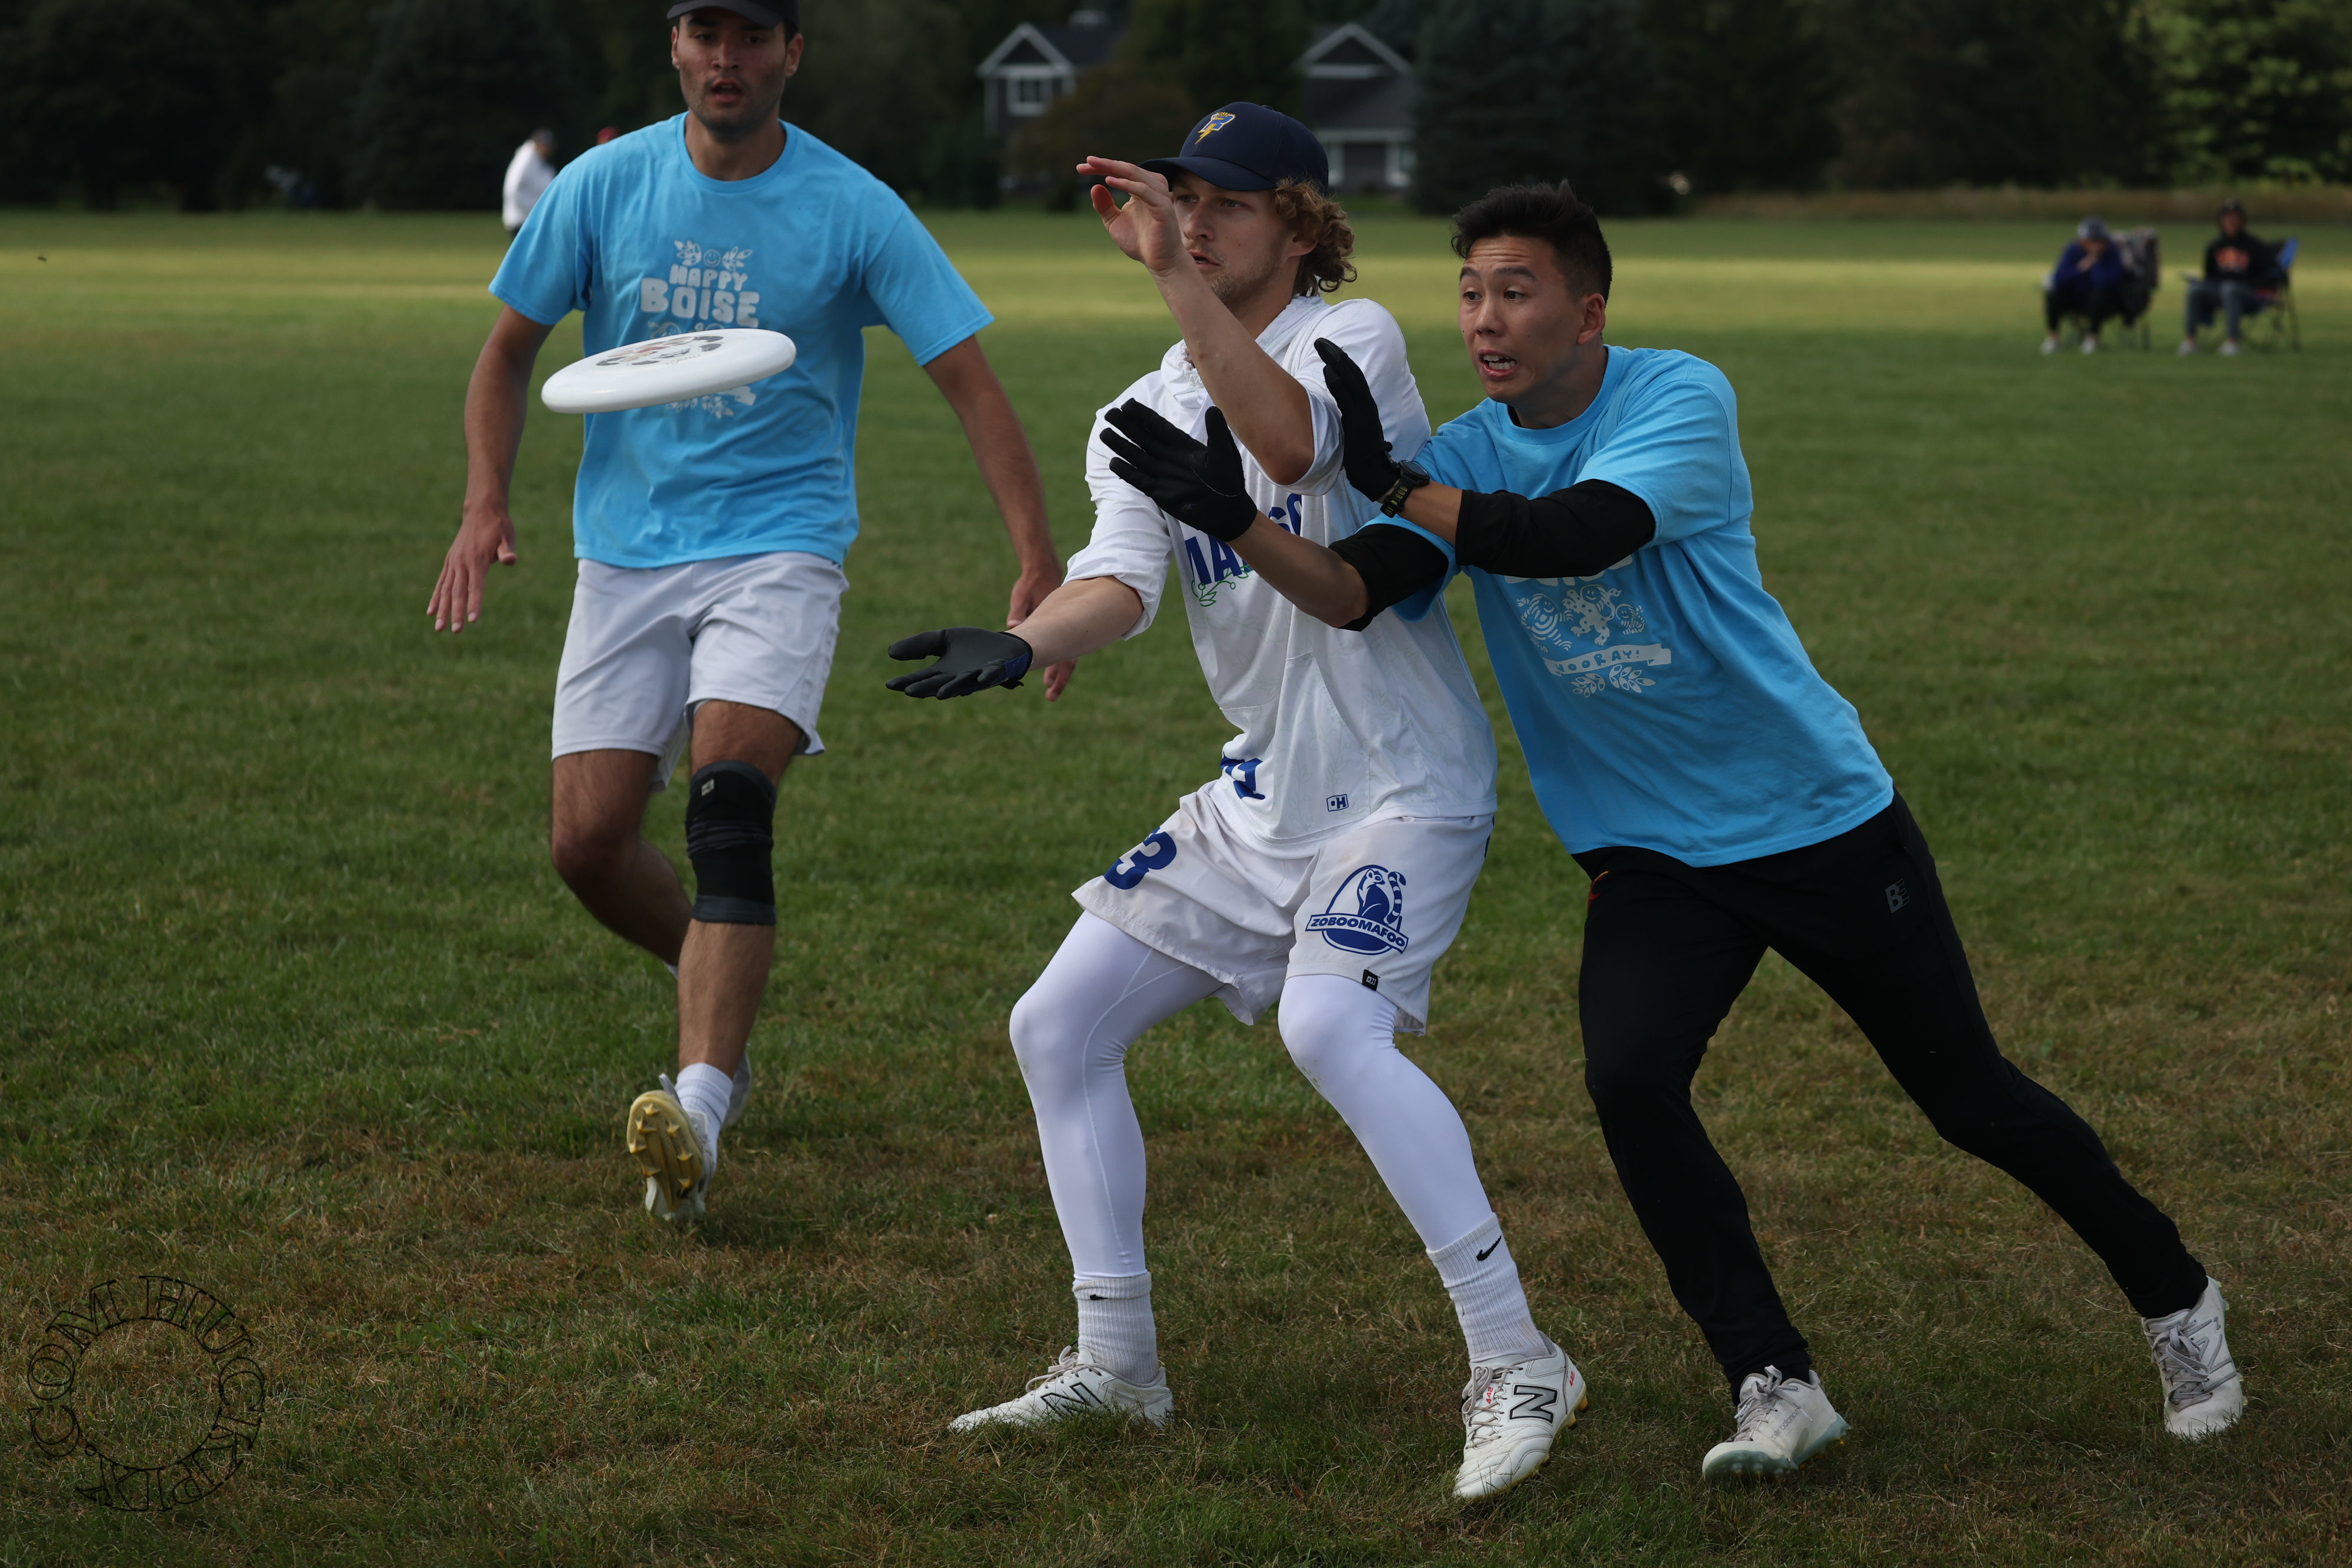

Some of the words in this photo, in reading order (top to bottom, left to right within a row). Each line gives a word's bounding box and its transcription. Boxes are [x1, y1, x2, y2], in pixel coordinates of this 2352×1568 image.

[669, 263, 748, 291] HAPPY
[641, 277, 760, 328] BOISE
[1311, 917, 1405, 947] ZOBOOMAFOO
